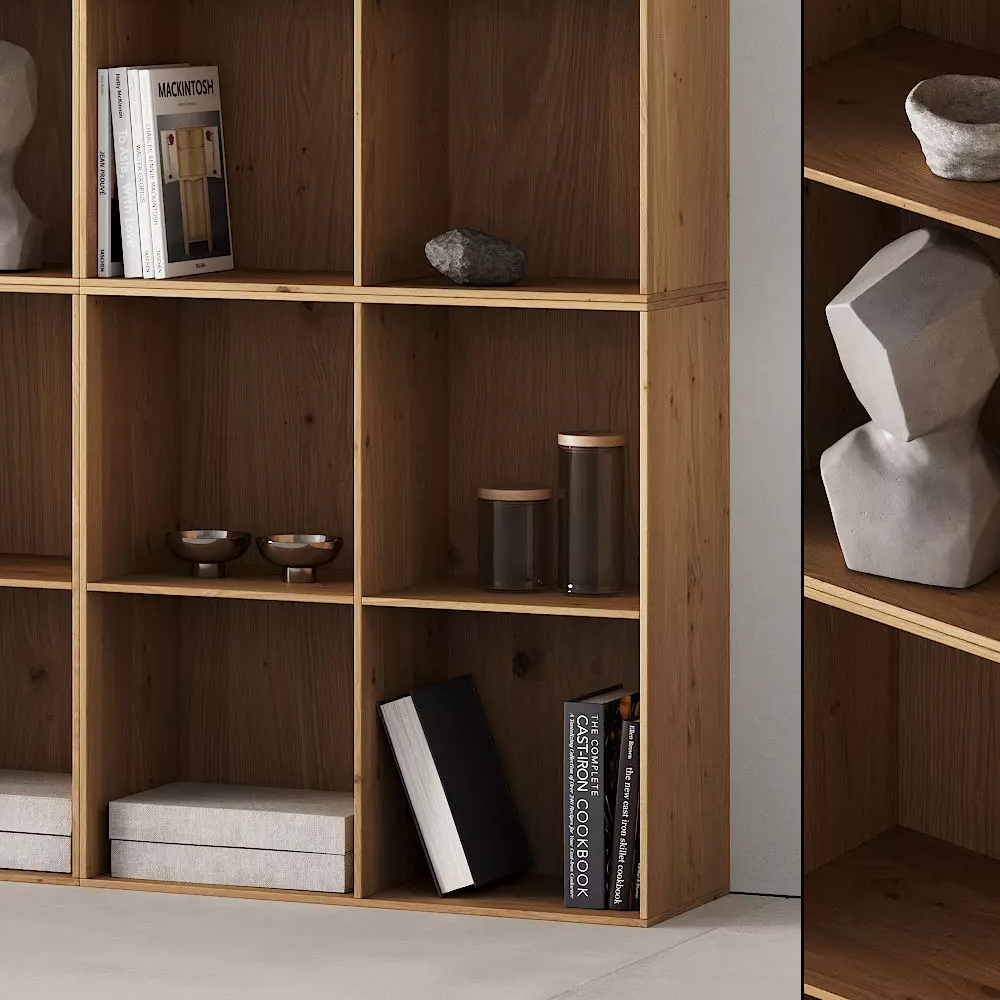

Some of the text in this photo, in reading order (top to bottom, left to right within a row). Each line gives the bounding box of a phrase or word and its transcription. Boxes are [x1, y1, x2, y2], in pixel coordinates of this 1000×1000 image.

[158, 79, 214, 98] MACKINTOSH
[118, 130, 128, 144] To
[122, 183, 134, 214] With
[138, 172, 146, 204] GROPIUS
[151, 181, 159, 226] MACKINTOSH
[125, 217, 136, 249] Love
[590, 714, 599, 797] THE COMPLETE
[627, 740, 635, 760] Brown
[625, 767, 634, 780] the
[623, 782, 631, 800] new
[576, 714, 589, 898] CAST-IRON COOKBOOK
[620, 819, 629, 837] iron
[618, 838, 628, 863] skillet
[613, 864, 625, 905] cookbook
